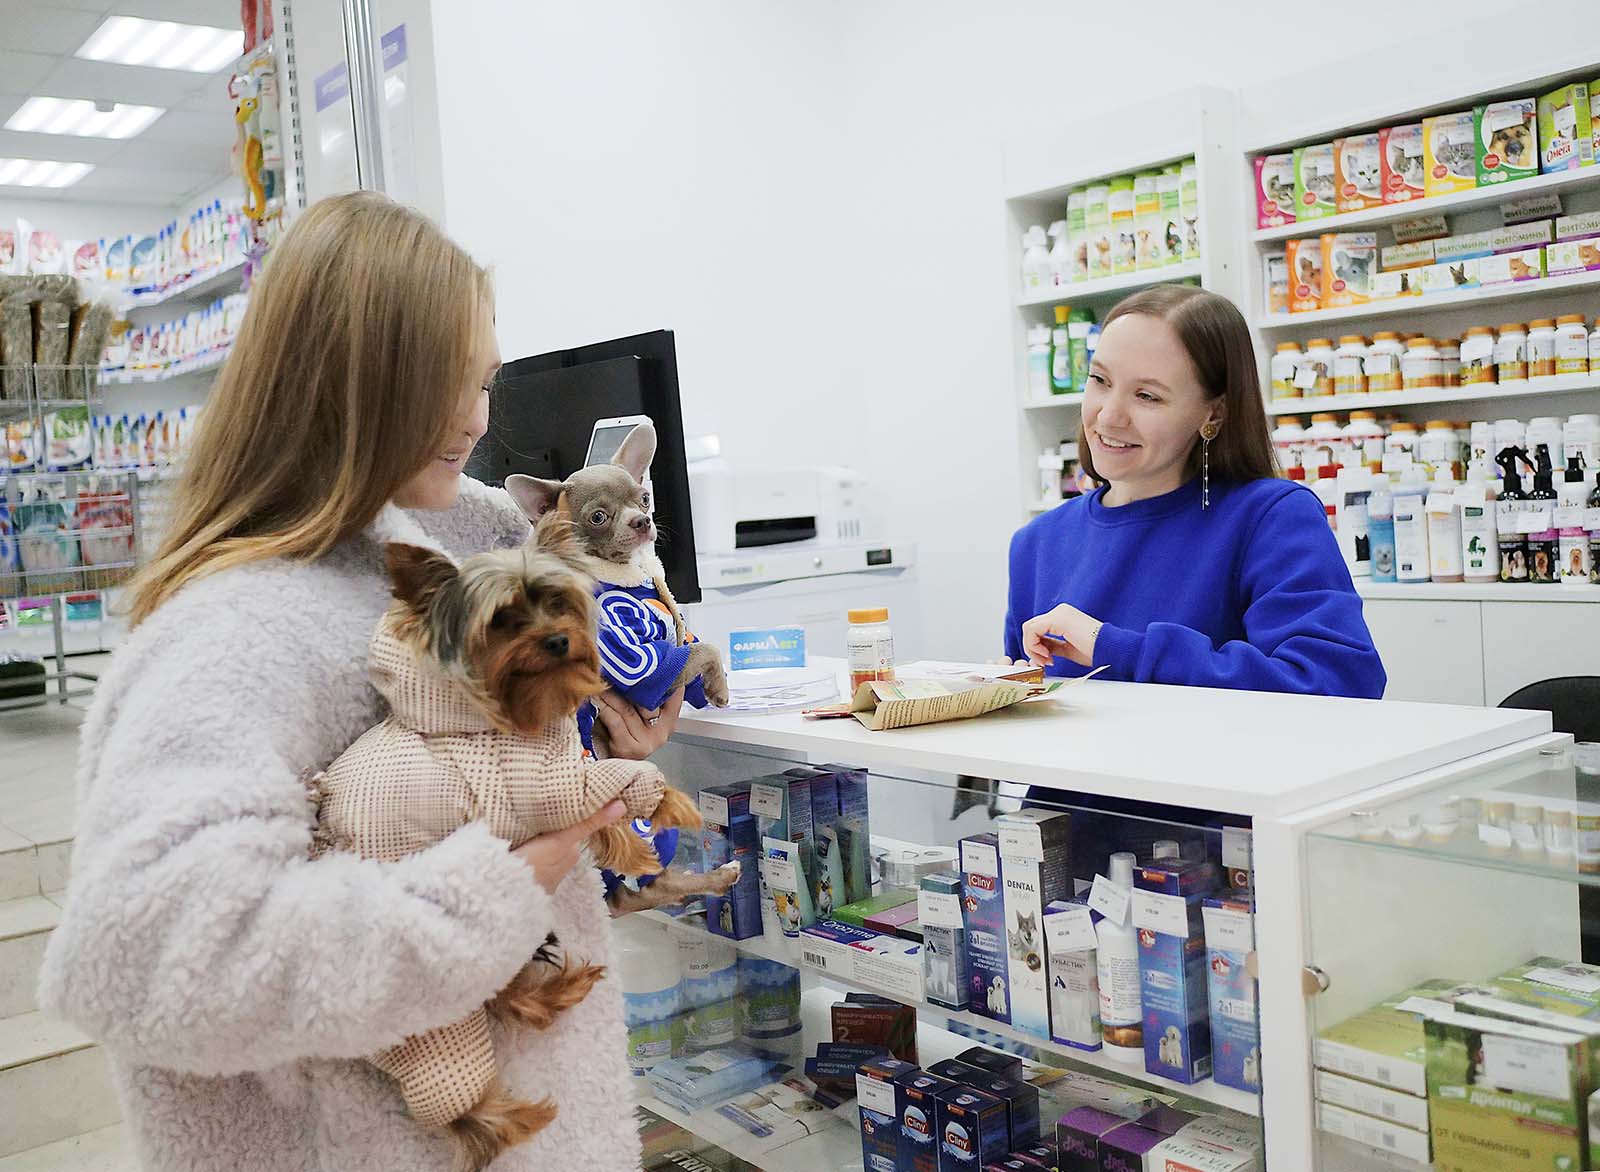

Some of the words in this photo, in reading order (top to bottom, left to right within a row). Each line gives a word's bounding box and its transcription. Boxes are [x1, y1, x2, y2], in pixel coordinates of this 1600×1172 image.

[1504, 203, 1557, 219] ФИТОМИНЫ
[1493, 231, 1546, 246] ФИТОМИНЫ
[1437, 240, 1489, 253] ФИТОМИНЫ
[971, 875, 992, 891] Cliny
[1007, 880, 1034, 892] DENTAL
[822, 920, 876, 938] Orozyme
[907, 1118, 926, 1133] Cliny
[948, 1134, 968, 1150] Cliny
